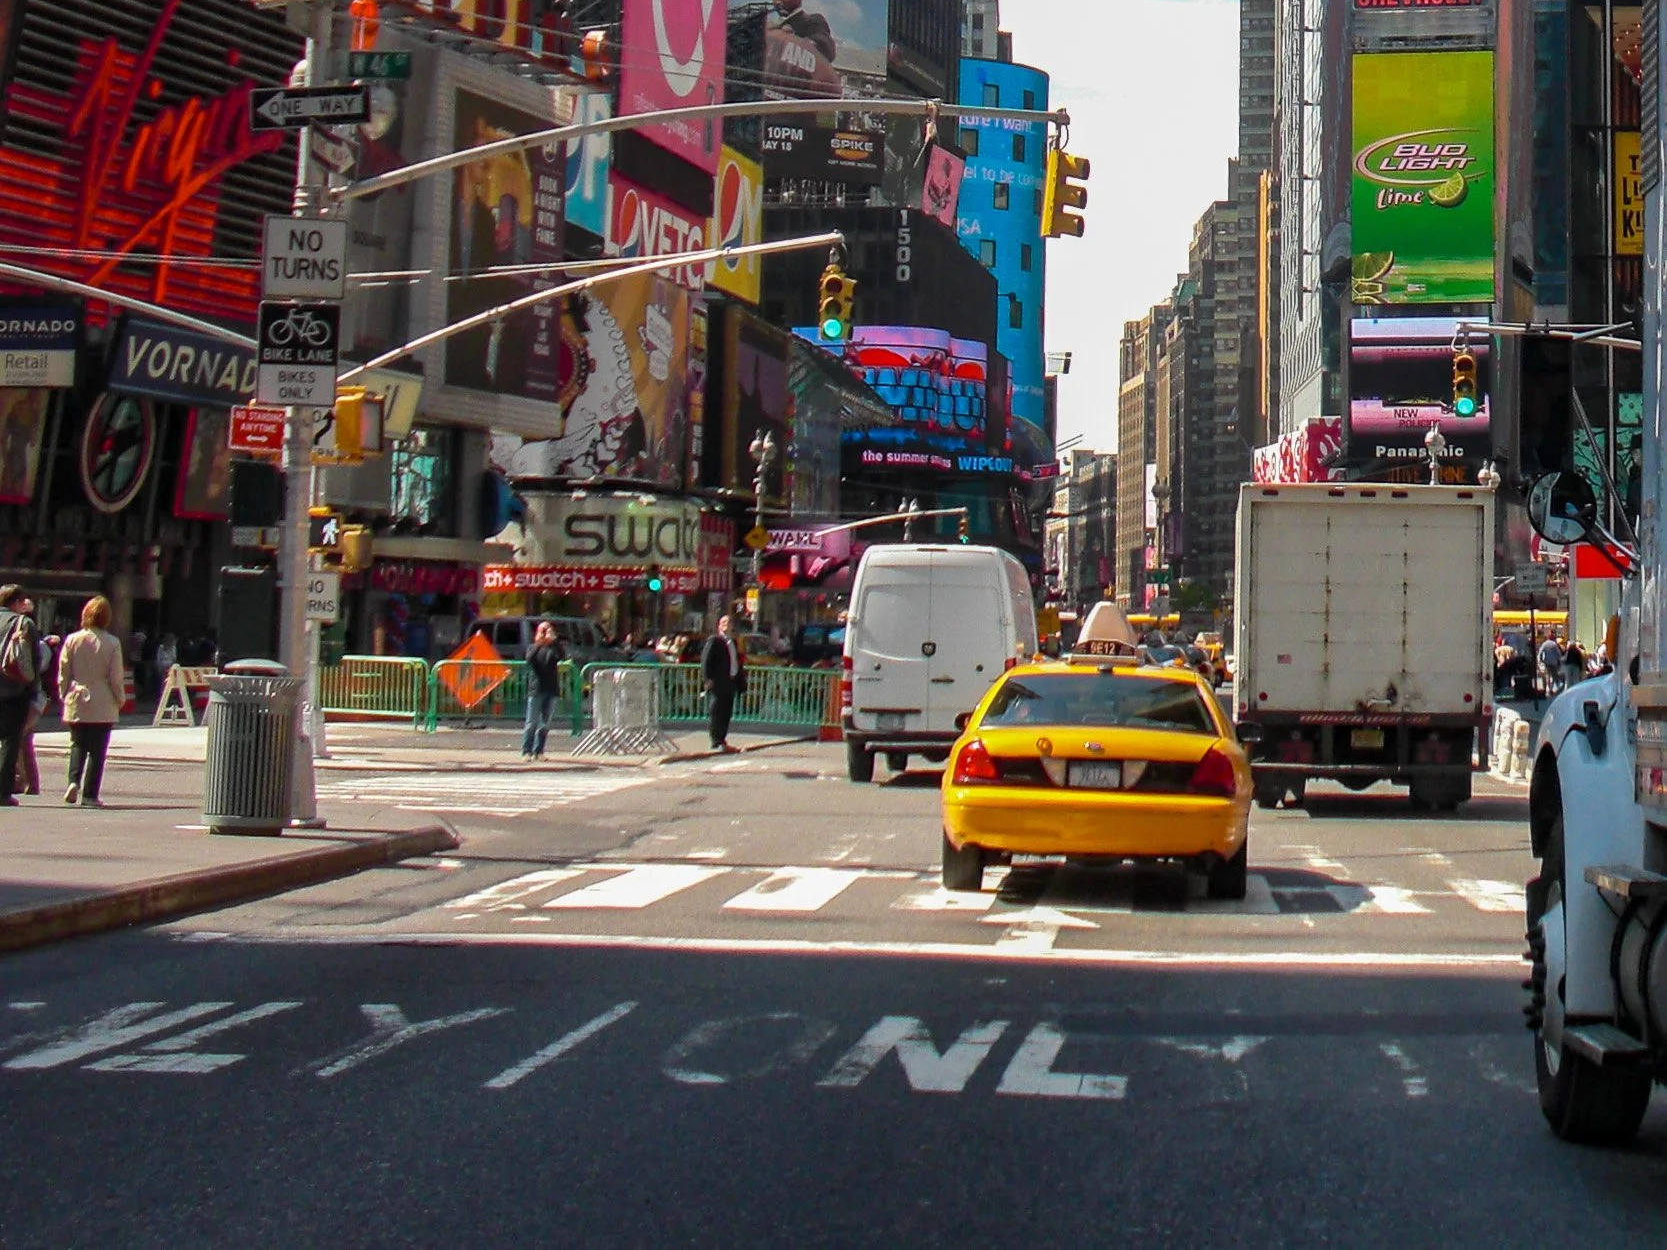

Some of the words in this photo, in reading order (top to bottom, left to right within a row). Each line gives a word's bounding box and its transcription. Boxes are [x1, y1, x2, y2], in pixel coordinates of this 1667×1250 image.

[269, 100, 303, 116] ONE
[318, 97, 355, 114] WAY
[767, 126, 803, 141] 10PM
[830, 138, 874, 152] SPIKE
[1391, 143, 1468, 157] BUD
[1379, 156, 1476, 171] LIGHT
[1376, 187, 1424, 210] Lime
[288, 230, 323, 252] NO
[272, 257, 339, 281] TURNS
[0, 320, 75, 332] ORNADO
[5, 353, 48, 369] Retail
[263, 348, 293, 361] BIKE
[297, 349, 333, 361] LANE
[127, 336, 257, 395] VORNAD
[278, 371, 316, 383] BIKES
[278, 387, 314, 399] ONLY
[1394, 409, 1418, 419] NEW
[863, 449, 883, 462] the
[886, 451, 929, 464] summer
[564, 509, 697, 559] swat
[515, 571, 585, 589] swatch
